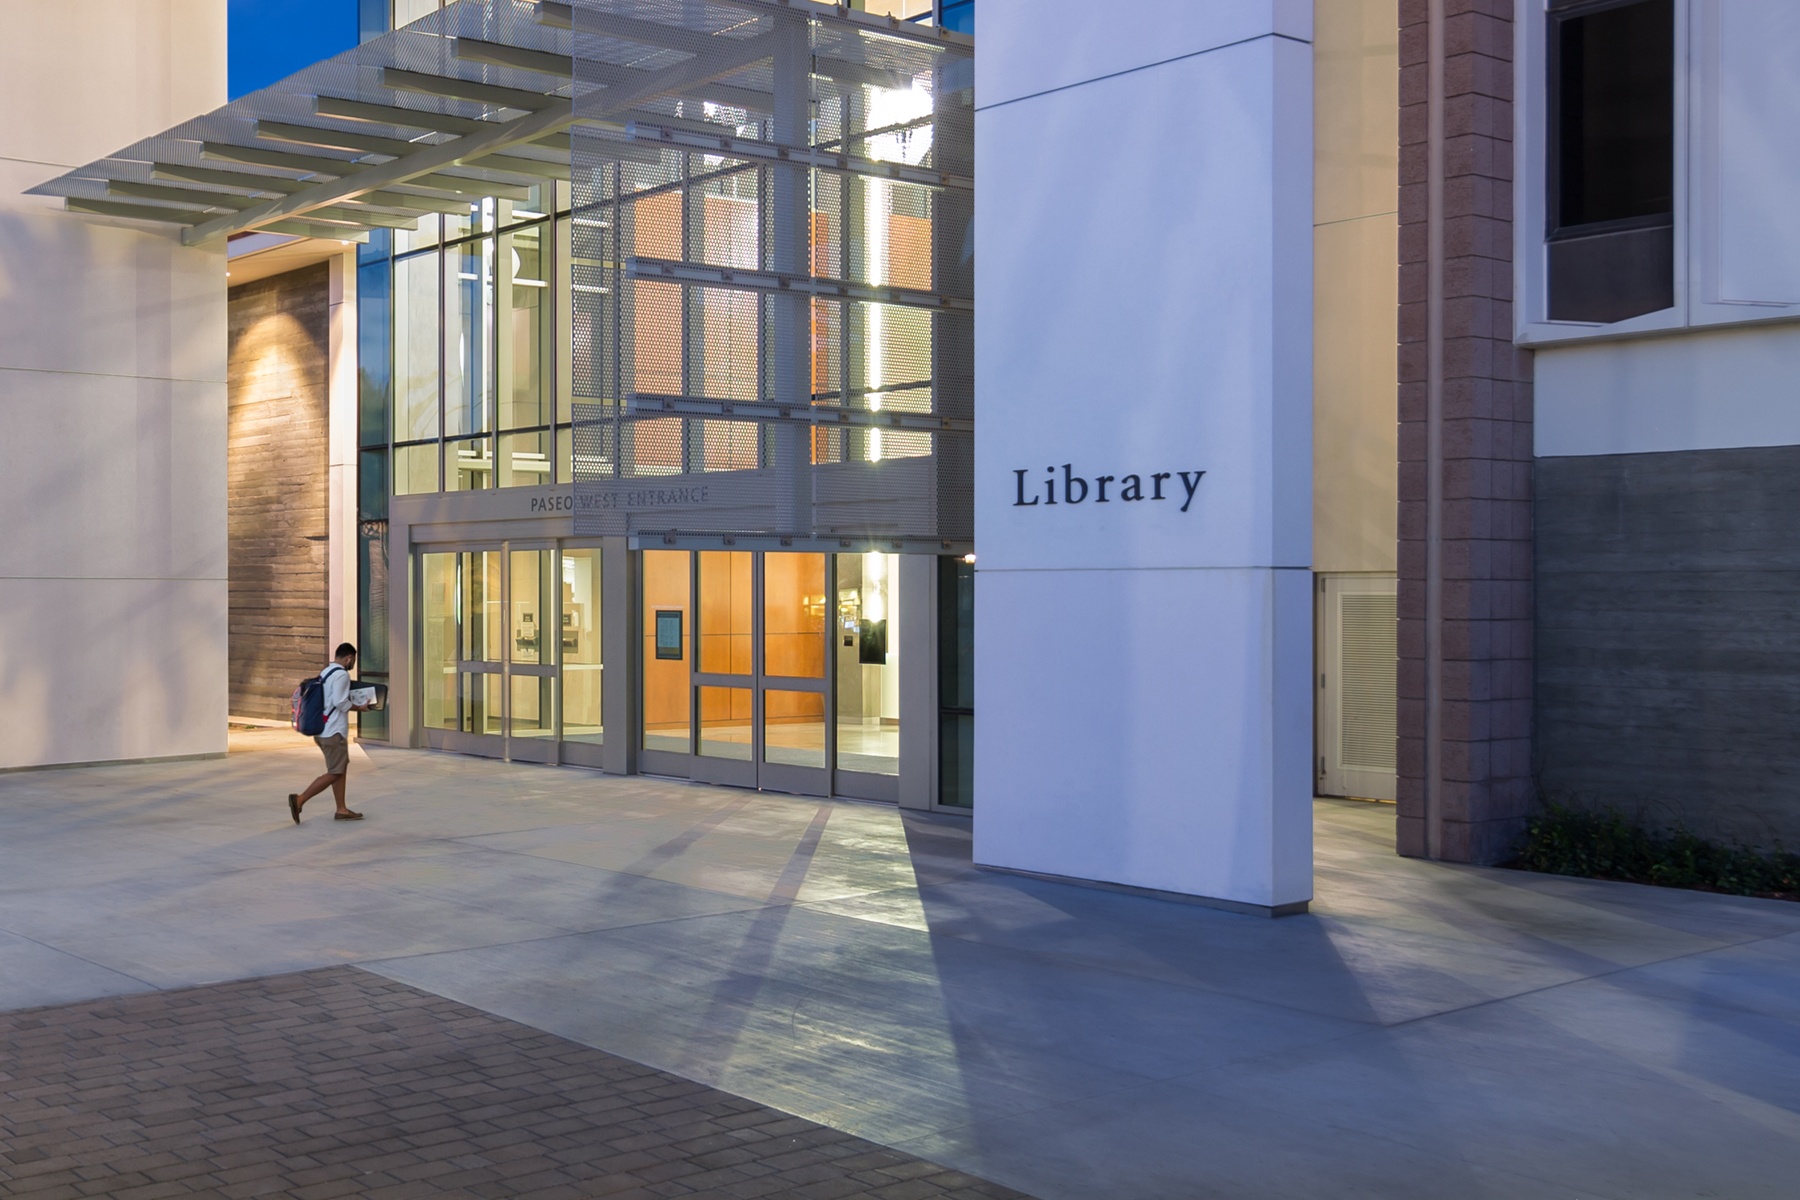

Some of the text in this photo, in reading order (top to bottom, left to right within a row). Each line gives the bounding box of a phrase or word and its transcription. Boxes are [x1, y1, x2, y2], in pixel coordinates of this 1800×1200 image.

[531, 486, 708, 512] PASEO WEST ENTRANCE
[1012, 463, 1206, 512] Library
